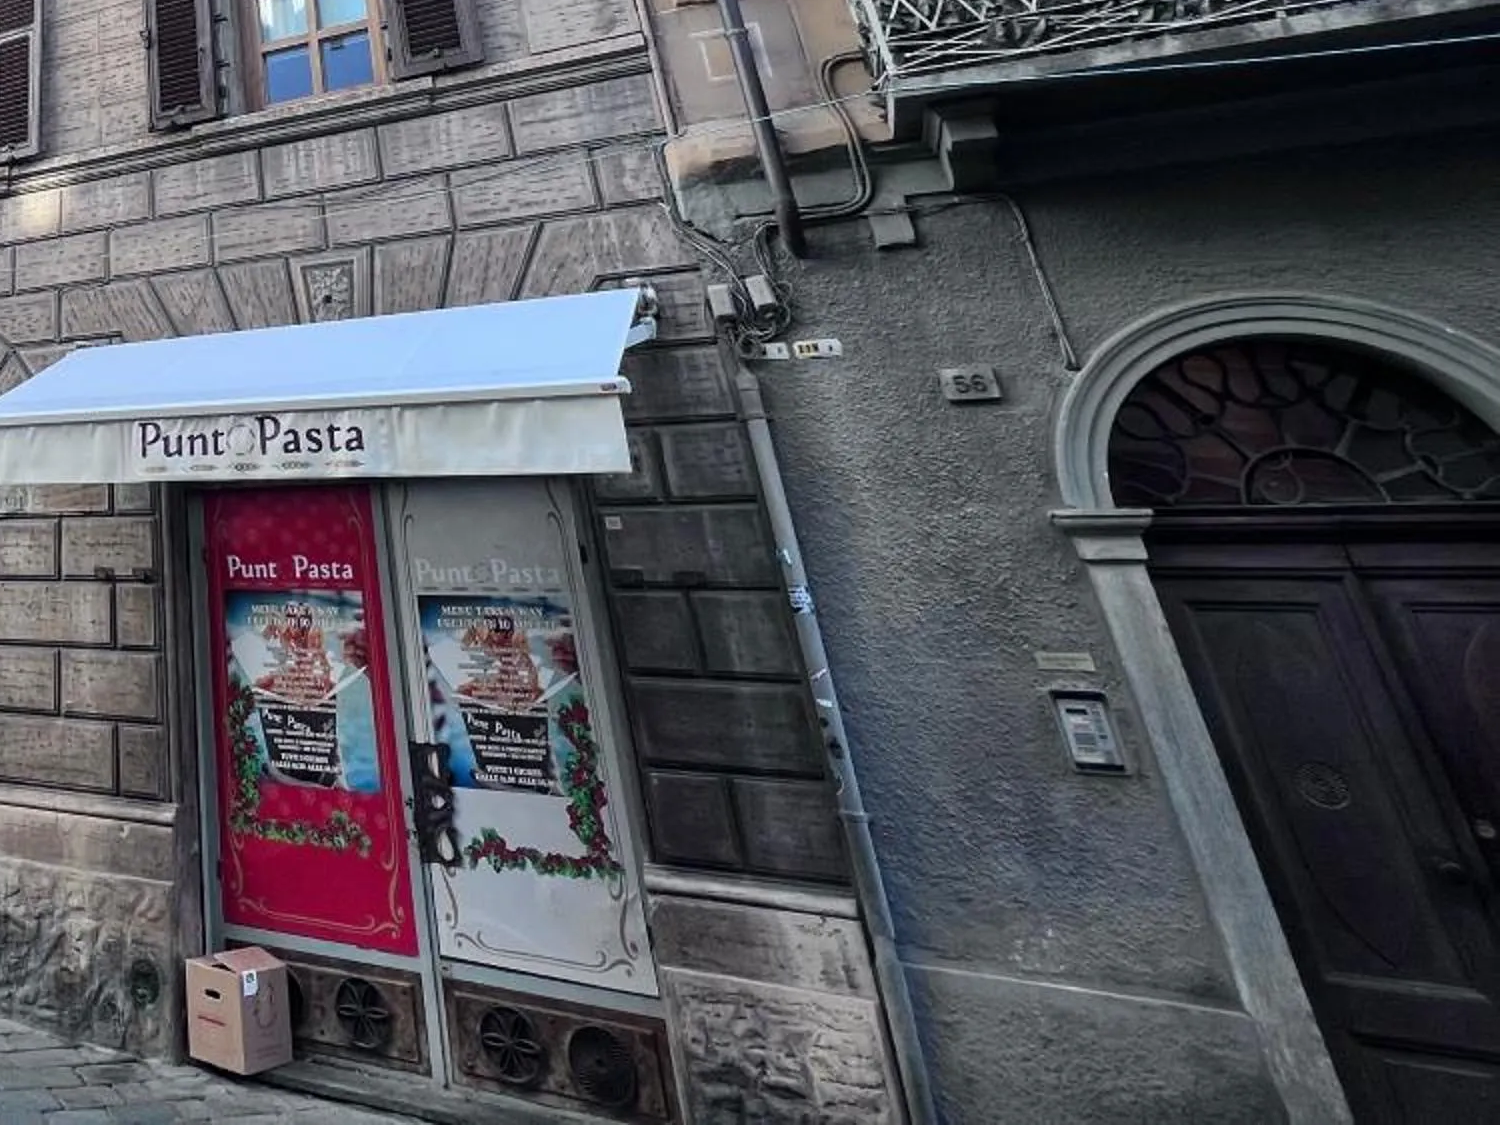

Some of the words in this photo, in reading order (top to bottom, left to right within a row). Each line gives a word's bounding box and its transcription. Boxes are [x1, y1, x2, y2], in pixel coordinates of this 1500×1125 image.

[254, 414, 366, 456] Pasta
[291, 554, 353, 579] Pasta
[489, 556, 561, 585] Pasta
